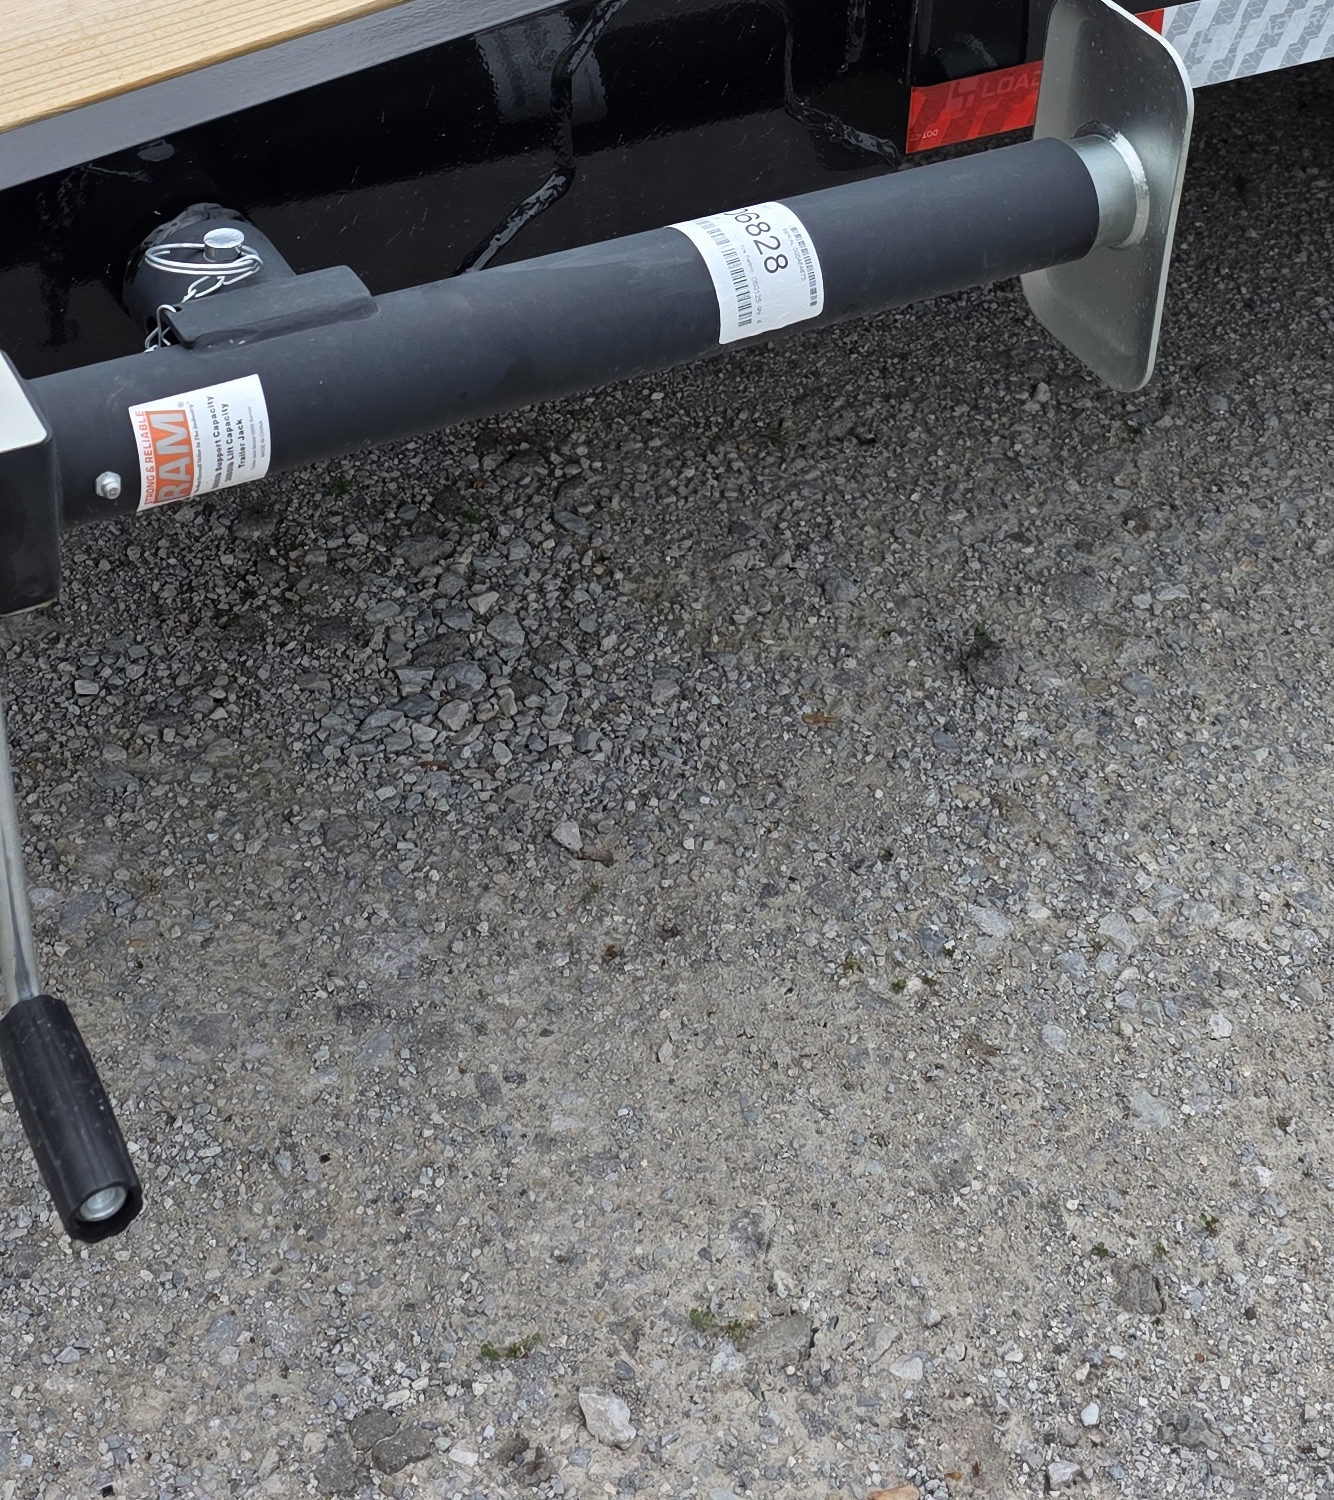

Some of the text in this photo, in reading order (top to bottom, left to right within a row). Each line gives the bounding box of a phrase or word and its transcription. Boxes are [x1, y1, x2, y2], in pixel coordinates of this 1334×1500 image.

[207, 396, 221, 439] Capacity
[221, 403, 234, 444] Capacity
[135, 410, 155, 505] STRONG & RELIABLE
[149, 412, 192, 501] RAM
[215, 439, 224, 474] Support
[236, 419, 246, 469] Trailer Jack
